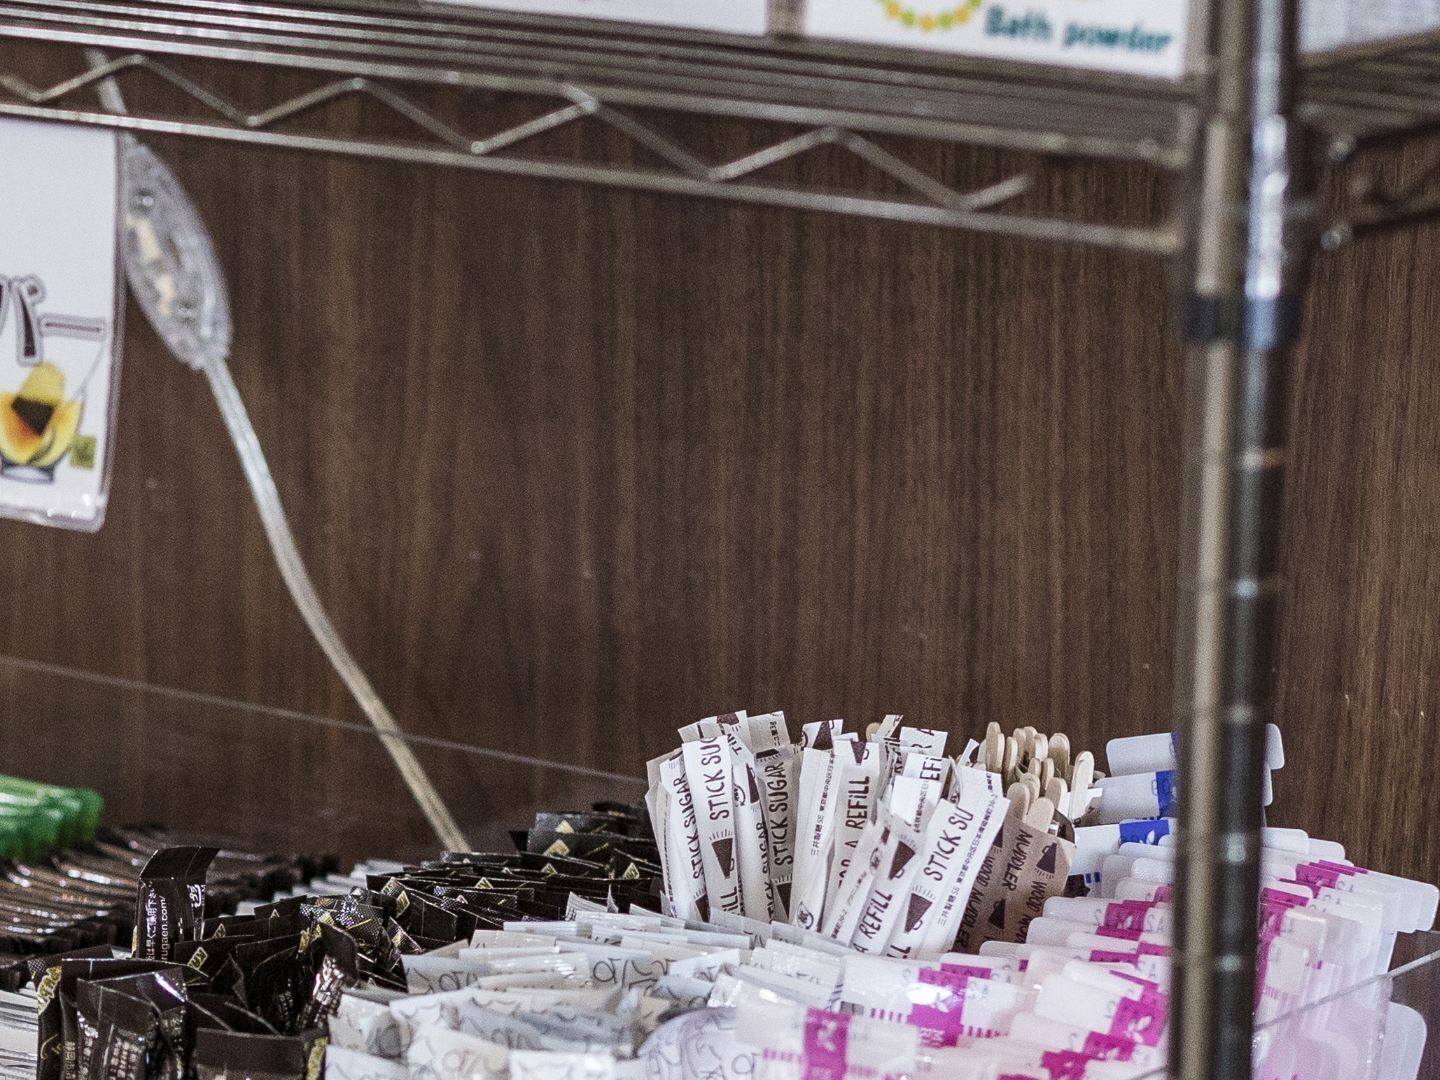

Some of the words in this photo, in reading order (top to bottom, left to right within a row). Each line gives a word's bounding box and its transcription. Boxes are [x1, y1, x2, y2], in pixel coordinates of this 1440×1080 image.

[984, 5, 1054, 40] Bath
[765, 761, 789, 813] SUGAR
[769, 821, 794, 867] STICK
[923, 829, 962, 883] STICK
[1002, 829, 1034, 893] MUDDLER
[1025, 880, 1048, 912] WOOD
